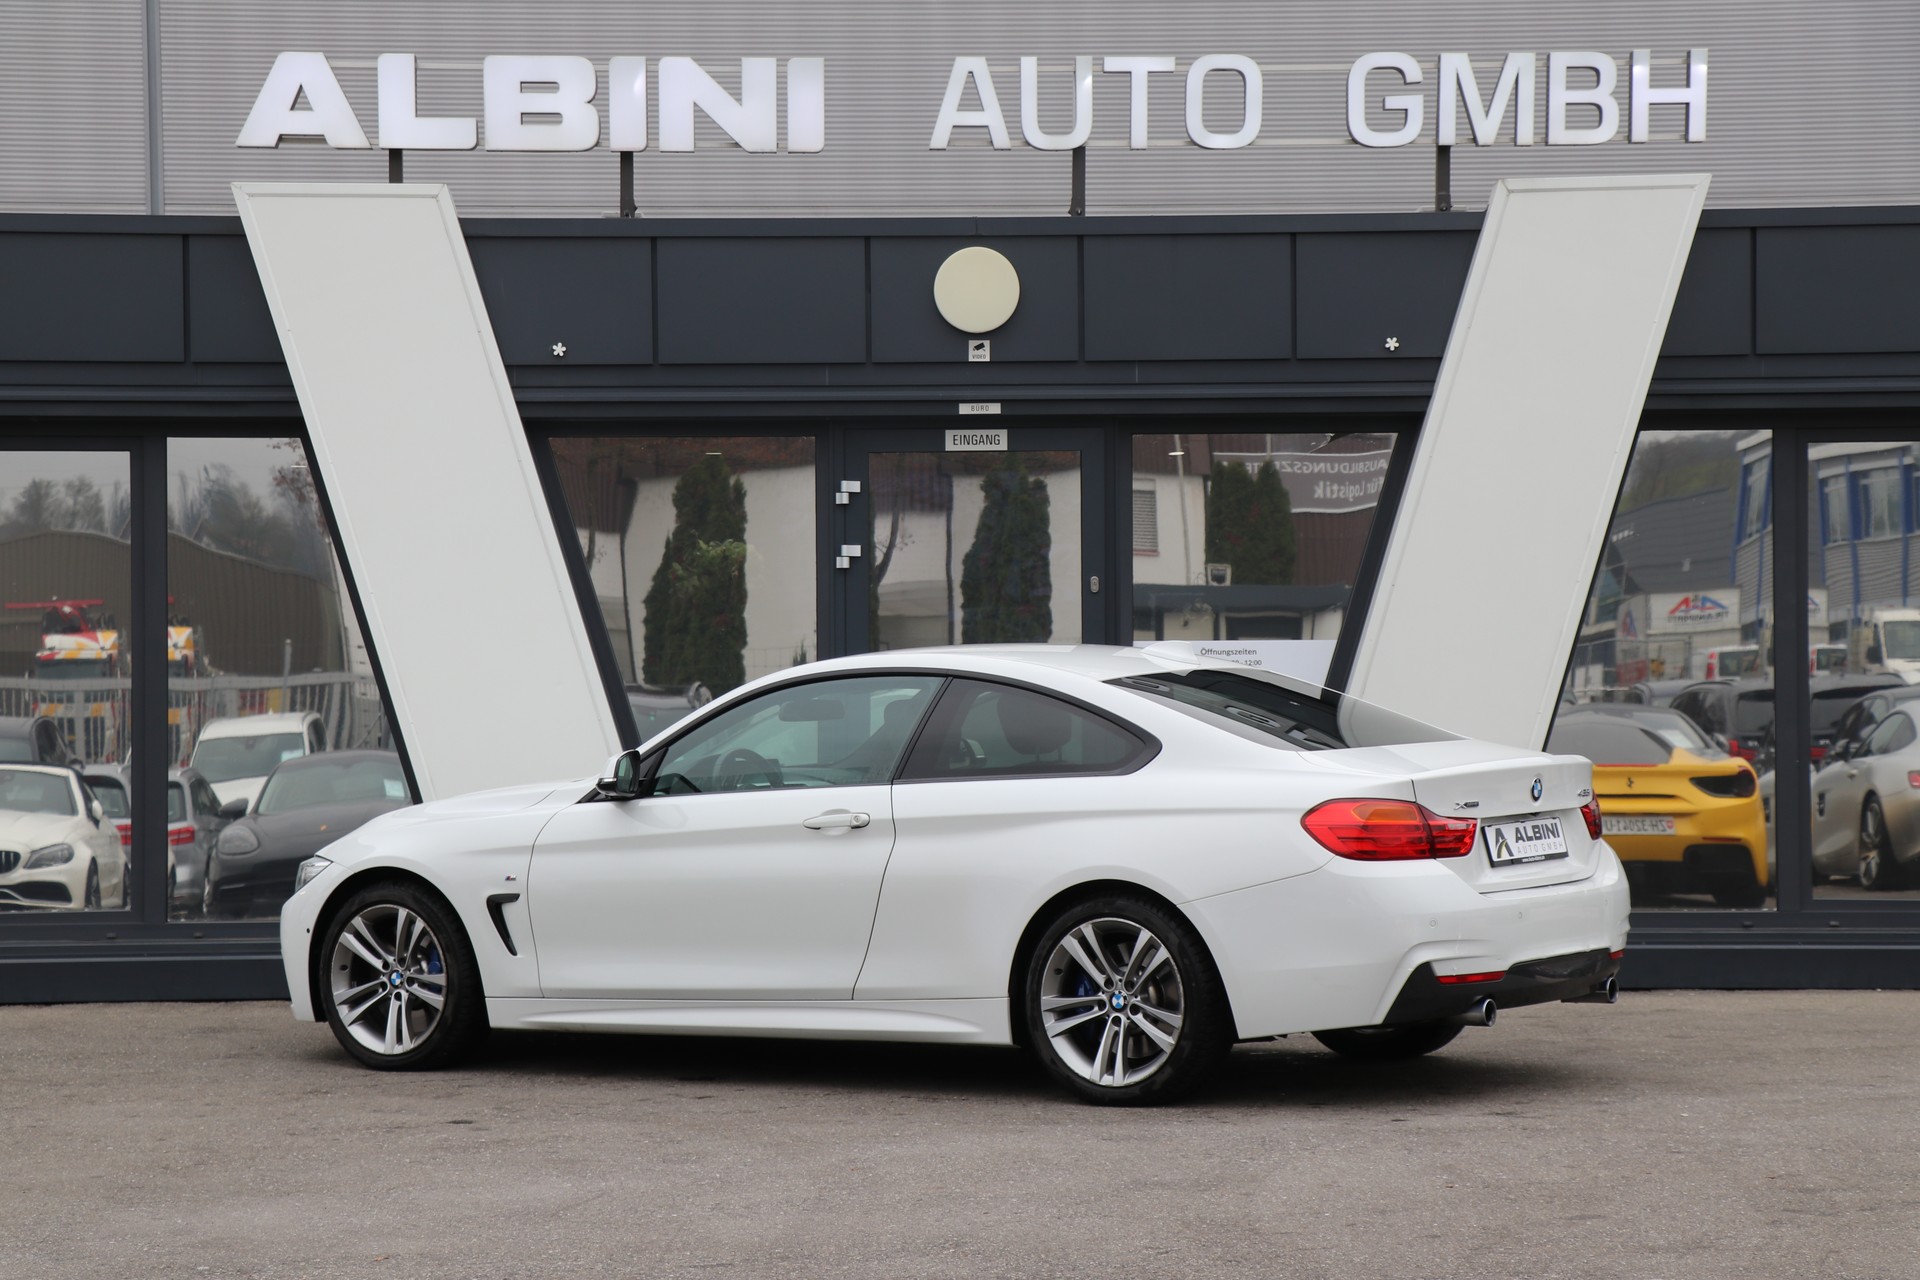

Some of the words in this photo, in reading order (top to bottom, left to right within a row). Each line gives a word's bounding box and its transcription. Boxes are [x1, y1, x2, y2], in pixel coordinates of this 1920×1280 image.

[236, 51, 825, 153] ALBINI
[929, 53, 1263, 151] AUTO
[1346, 48, 1708, 148] GMBH
[970, 404, 990, 412] BÜRO
[952, 433, 1001, 446] EINGANG
[1200, 647, 1257, 658] Öffnungszeiten
[1515, 822, 1561, 844] ALBINI
[1517, 843, 1539, 856] AUTO
[1541, 841, 1564, 853] GMBH
